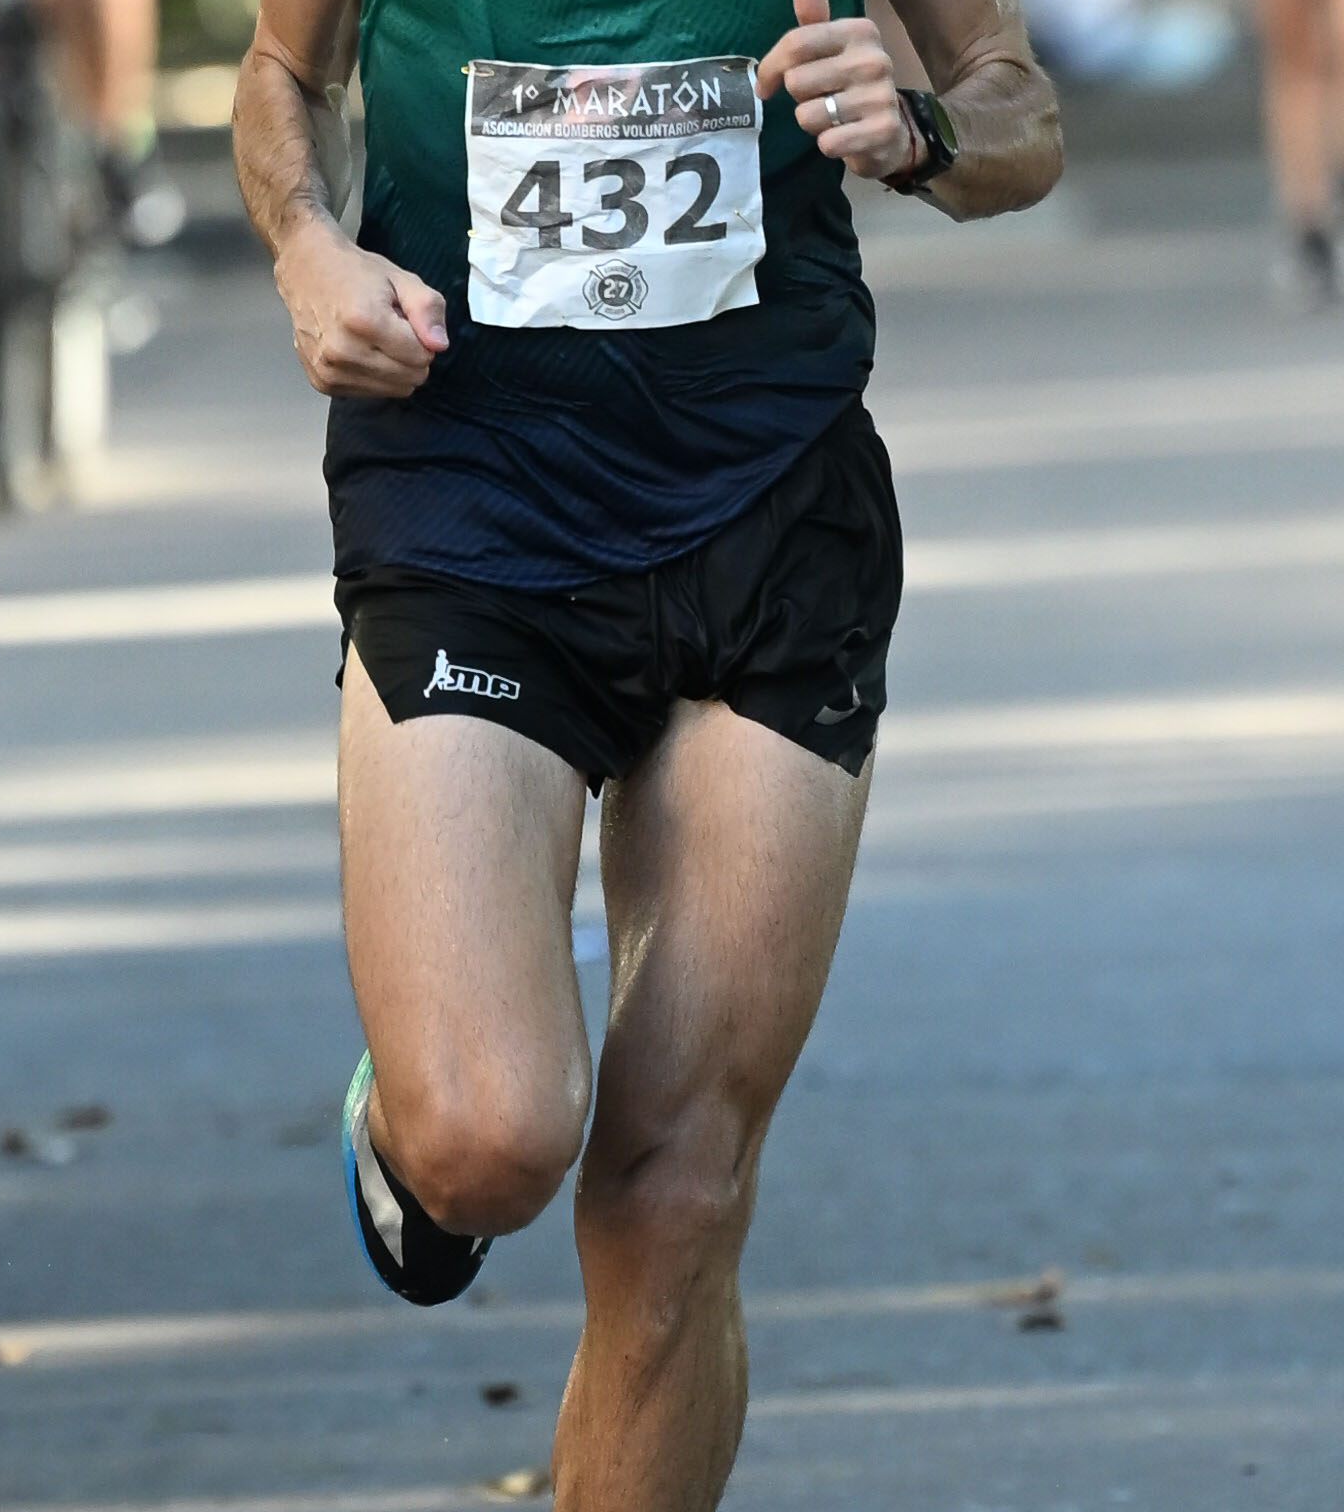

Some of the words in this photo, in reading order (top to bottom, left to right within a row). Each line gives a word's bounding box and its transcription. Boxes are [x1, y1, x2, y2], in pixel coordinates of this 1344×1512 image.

[552, 70, 721, 118] MARATÓN
[482, 120, 552, 137] ASOCIACIÓN
[554, 122, 620, 139] BOMBEROS
[622, 119, 699, 138] VOLUNTARIOS
[702, 113, 751, 130] ROSARIO
[500, 152, 728, 251] 432
[603, 277, 630, 300] 27
